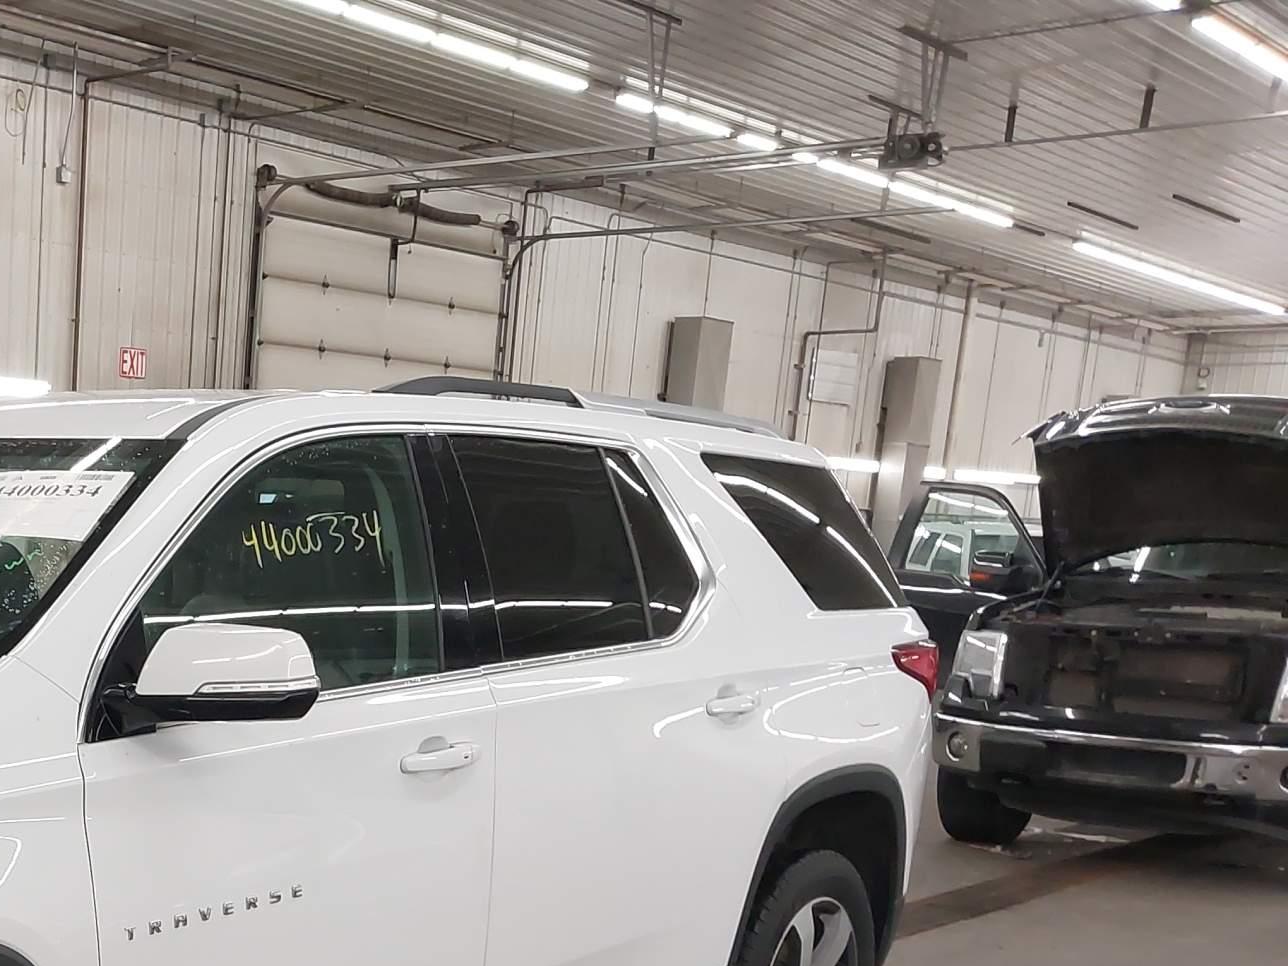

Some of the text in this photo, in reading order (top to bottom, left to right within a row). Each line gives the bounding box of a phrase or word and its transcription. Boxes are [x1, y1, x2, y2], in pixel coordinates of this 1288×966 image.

[121, 349, 147, 377] EXIT
[241, 509, 386, 569] 44000334
[123, 884, 304, 942] TRAVERSE
